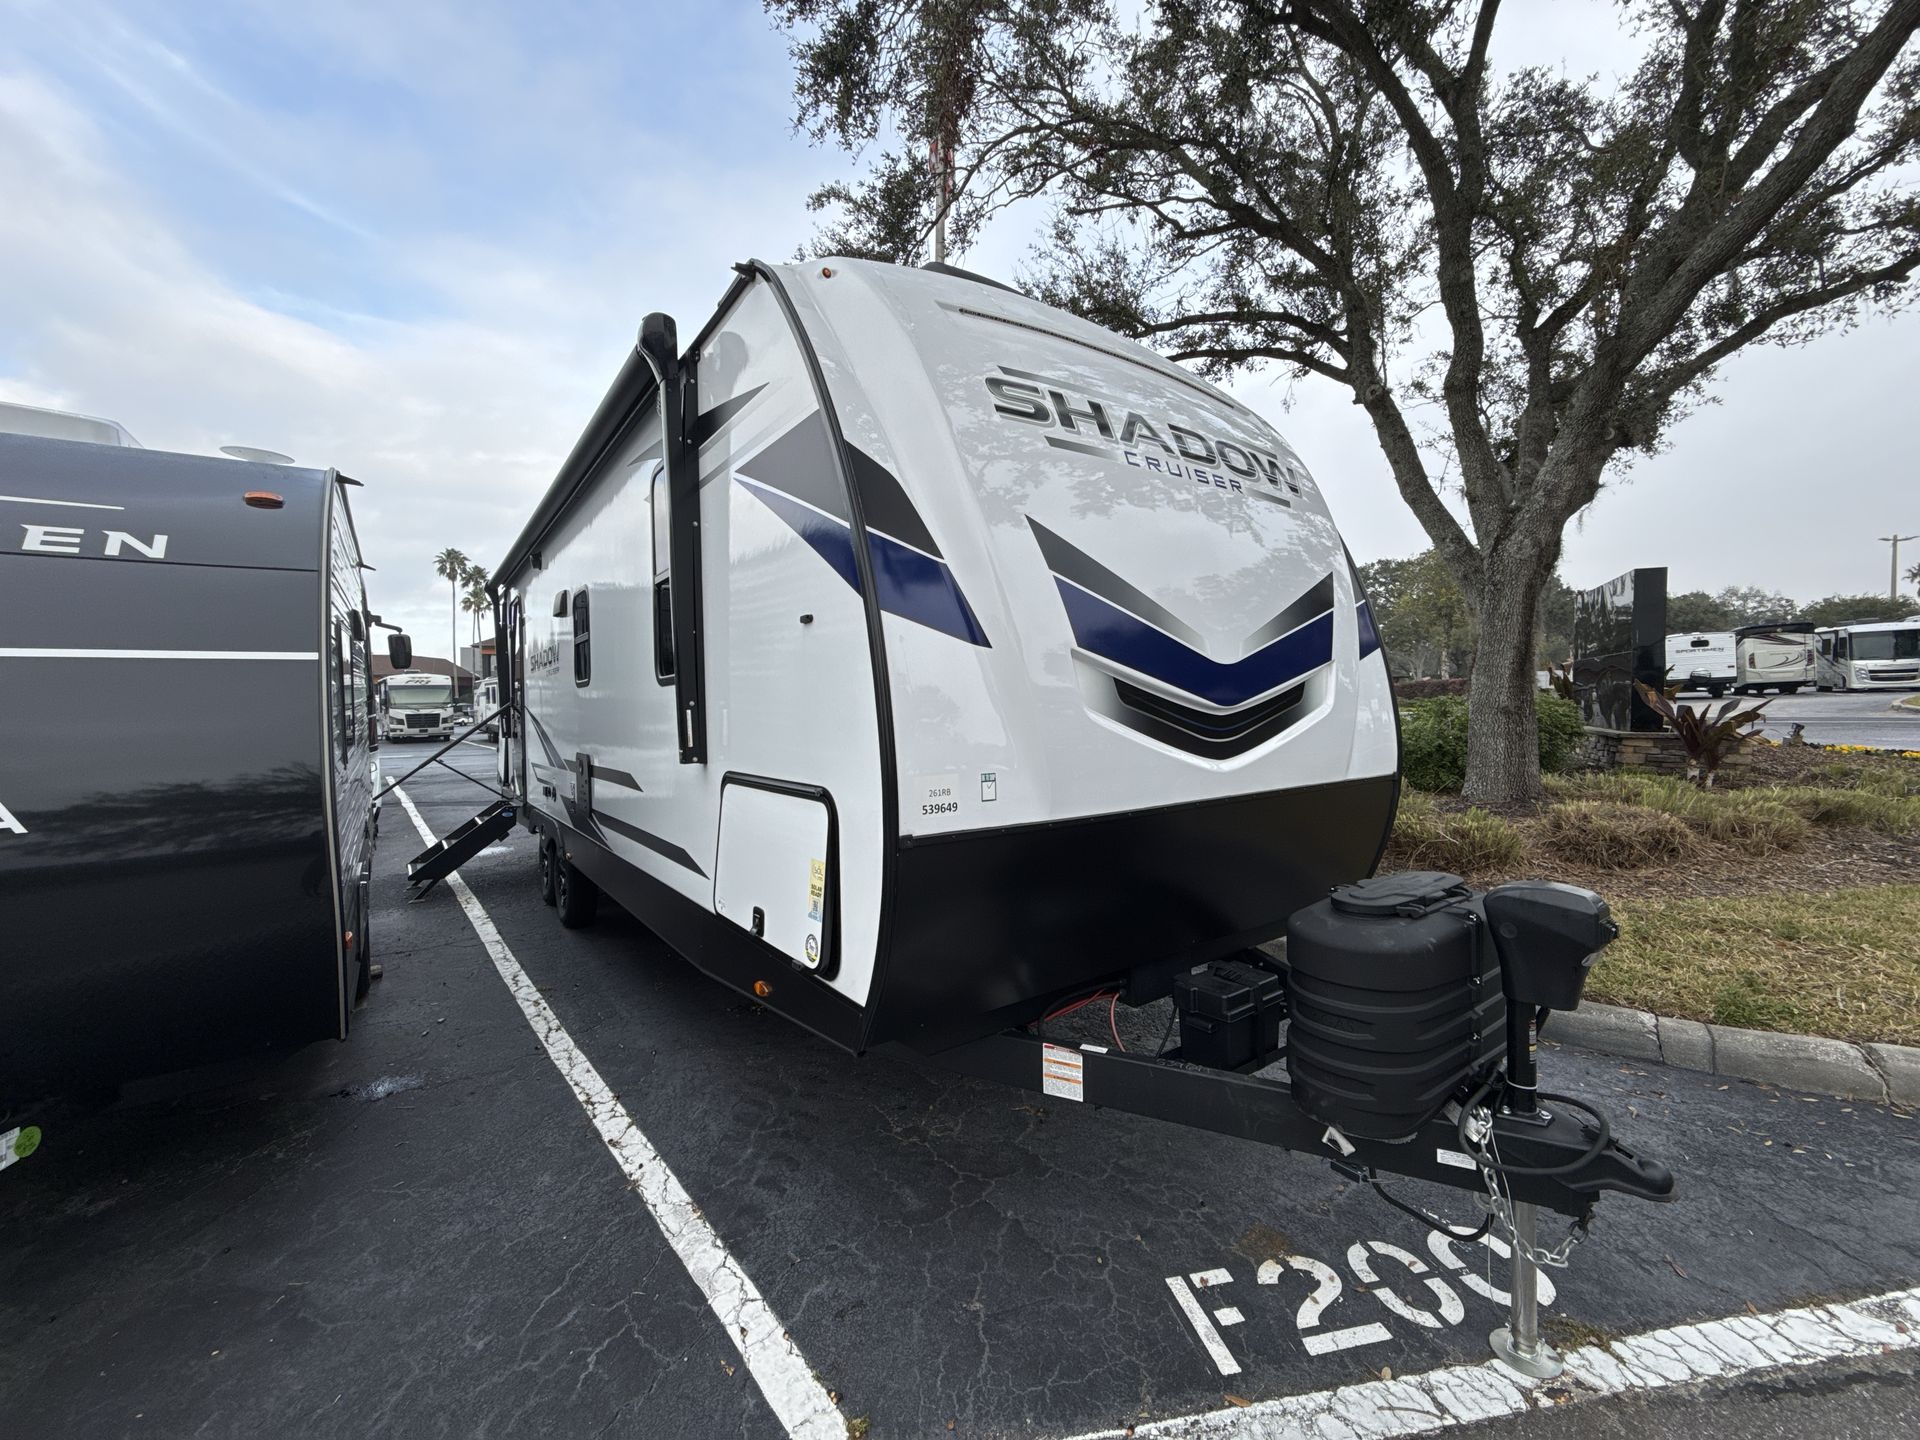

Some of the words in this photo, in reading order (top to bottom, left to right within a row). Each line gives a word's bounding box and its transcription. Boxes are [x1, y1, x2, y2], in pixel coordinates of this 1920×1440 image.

[984, 376, 1303, 497] SHADOW
[1123, 450, 1243, 494] CRUISER
[530, 643, 560, 673] SHADOW
[928, 788, 951, 798] 261RB
[922, 802, 958, 815] 539649
